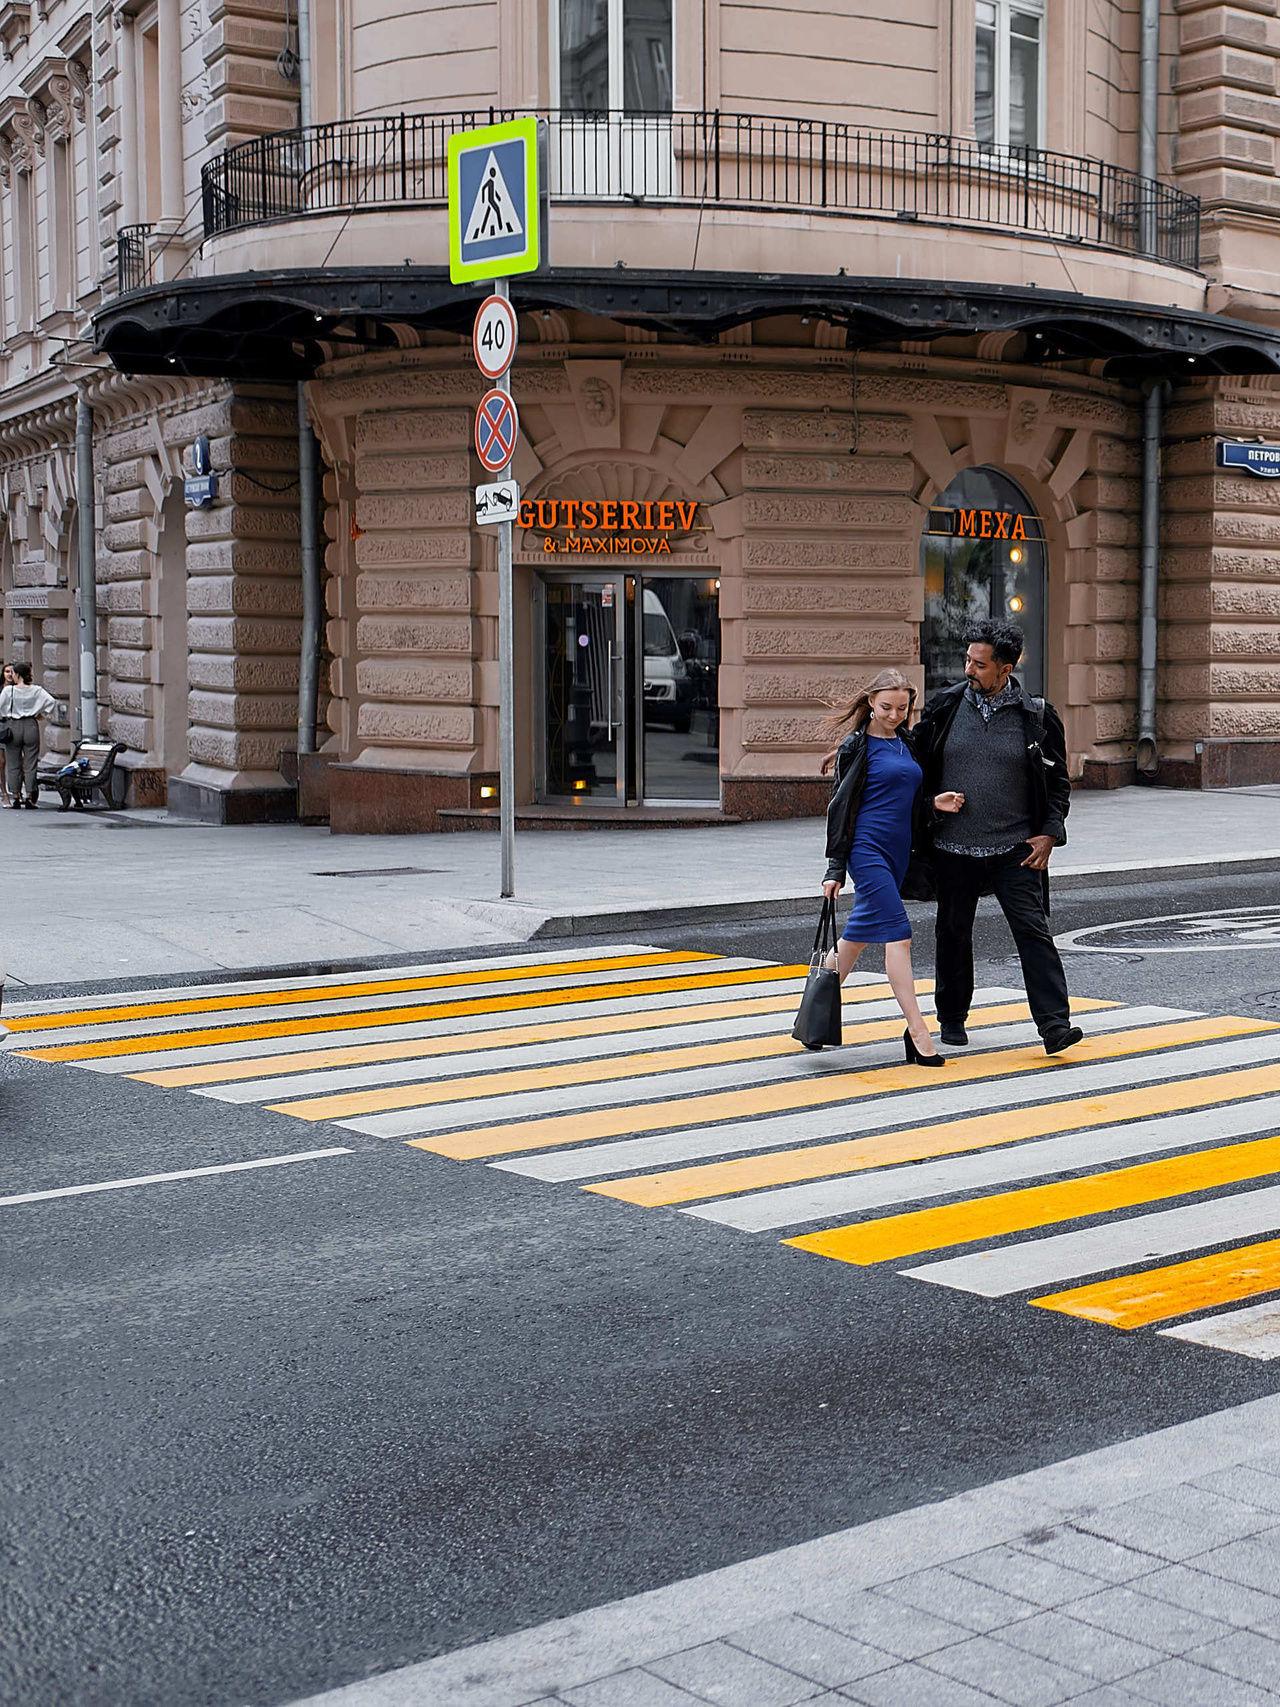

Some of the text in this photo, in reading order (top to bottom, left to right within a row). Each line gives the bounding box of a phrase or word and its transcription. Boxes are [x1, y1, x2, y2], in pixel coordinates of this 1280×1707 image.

[481, 319, 506, 351] 40
[1260, 466, 1280, 474] УЛИЦА
[517, 500, 699, 531] GUTSERIEV
[958, 509, 1028, 540] МЕХА
[543, 536, 672, 554] & MAXIMOVA
